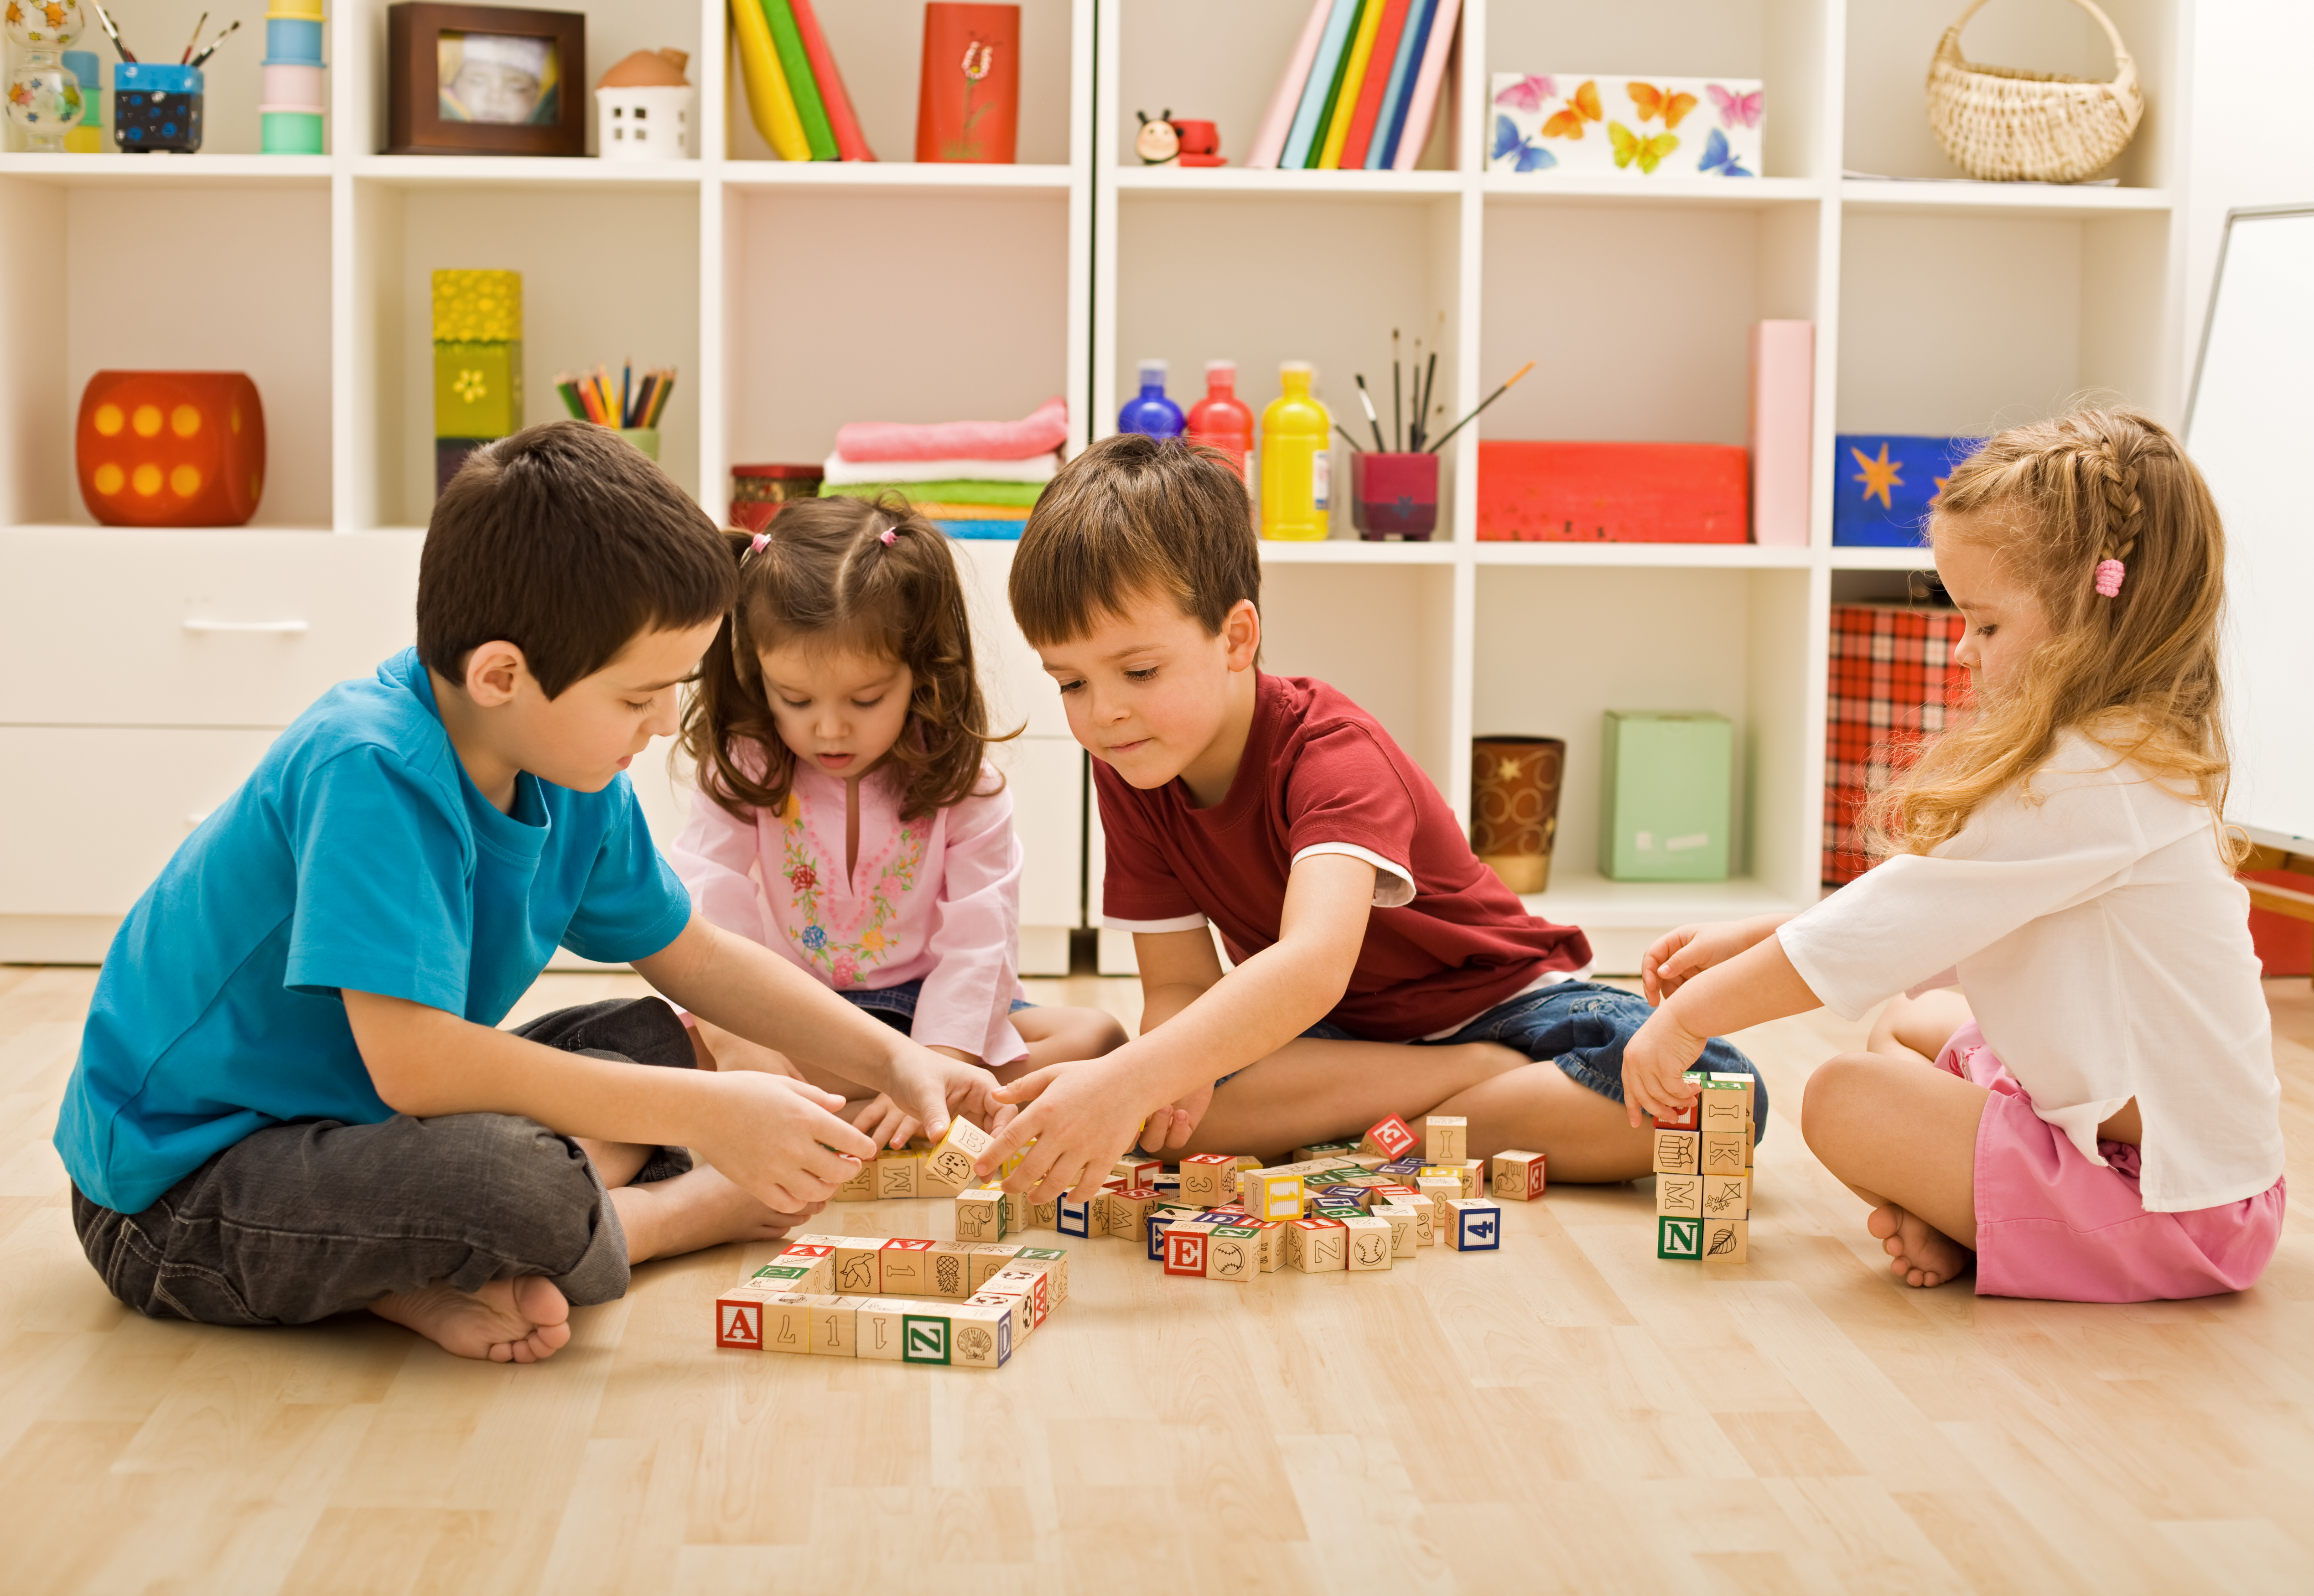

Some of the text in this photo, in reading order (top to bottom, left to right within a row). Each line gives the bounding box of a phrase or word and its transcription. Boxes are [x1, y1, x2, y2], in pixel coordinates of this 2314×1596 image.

[1709, 1104, 1739, 1119] I
[959, 1125, 986, 1152] B
[1377, 1123, 1409, 1151] E
[1440, 1130, 1453, 1158] I
[1710, 1141, 1739, 1165] K
[843, 1168, 870, 1192] K
[883, 1166, 911, 1194] M
[1271, 1191, 1298, 1205] 1
[1665, 1181, 1694, 1210] M
[1113, 1200, 1132, 1229] W
[1449, 1213, 1455, 1240] 4
[1391, 1223, 1407, 1250] A
[1468, 1221, 1493, 1238] 4
[1666, 1223, 1697, 1251] N
[788, 1247, 820, 1255] A
[895, 1240, 927, 1249] A
[1173, 1238, 1198, 1267] E
[887, 1265, 915, 1277] 1
[725, 1309, 757, 1340] A
[825, 1315, 840, 1346] 1
[873, 1318, 887, 1349] 1
[1000, 1323, 1010, 1358] D
